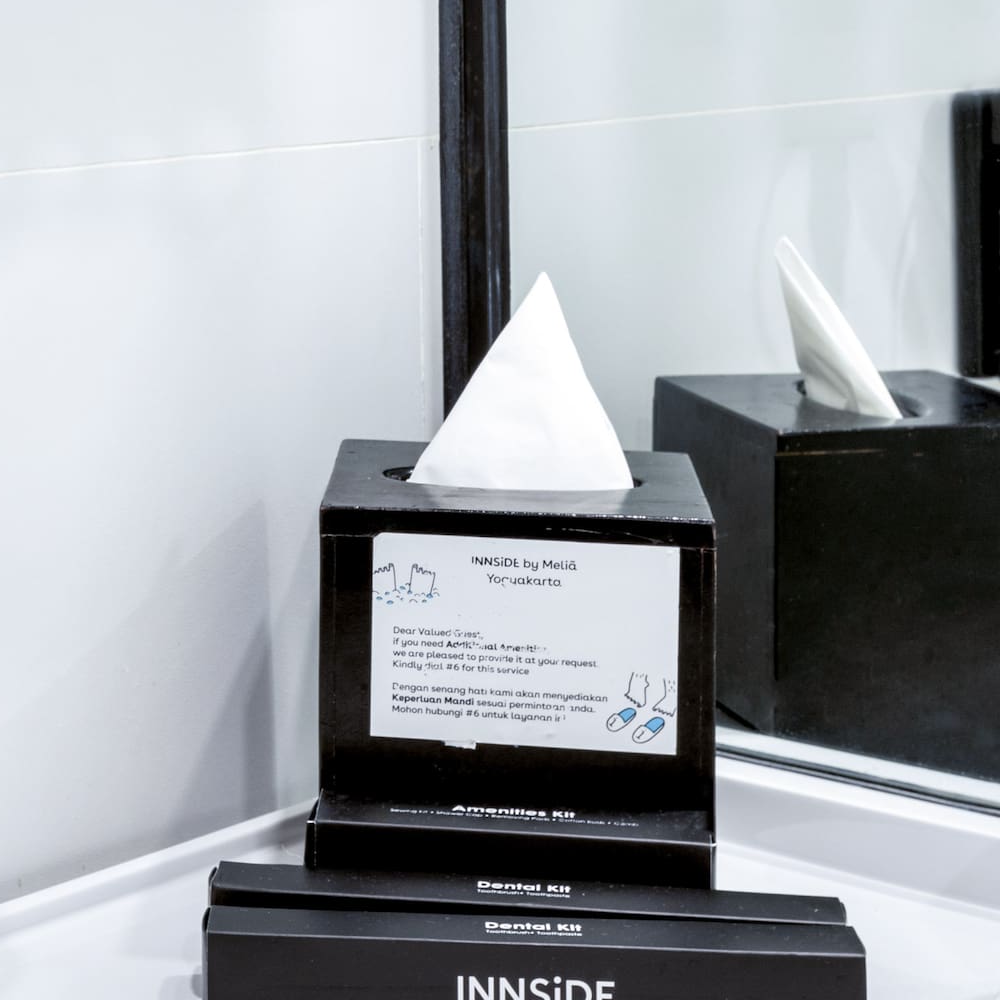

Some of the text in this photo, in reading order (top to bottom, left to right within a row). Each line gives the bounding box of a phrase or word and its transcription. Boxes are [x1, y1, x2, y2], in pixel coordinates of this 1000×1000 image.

[523, 558, 539, 571] by
[393, 626, 416, 635] Dear
[418, 627, 452, 637] Valued
[393, 637, 400, 645] if
[401, 639, 419, 648] you
[420, 640, 444, 648] need
[426, 650, 464, 660] pleased
[466, 653, 477, 661] to
[515, 655, 522, 664] it
[525, 656, 536, 664] at
[392, 660, 423, 671] Kindly
[446, 663, 460, 671] #6
[462, 663, 475, 672] for
[477, 664, 495, 673] this
[496, 667, 530, 675] service
[392, 693, 442, 704] Keperluan
[444, 697, 474, 706] Mandi
[476, 699, 507, 708] sesuai
[431, 685, 466, 696] senang
[489, 688, 513, 697] kami
[515, 690, 540, 699] akan
[542, 692, 608, 702] menyediakan
[392, 705, 423, 714] Mohon
[425, 707, 463, 718] hubungi
[466, 709, 480, 718] #6
[481, 711, 508, 719] untuk
[510, 712, 553, 722] layanan
[451, 804, 576, 819] Amenities Kit
[477, 881, 571, 893] Dental Kit
[485, 921, 582, 932] Dental Kit
